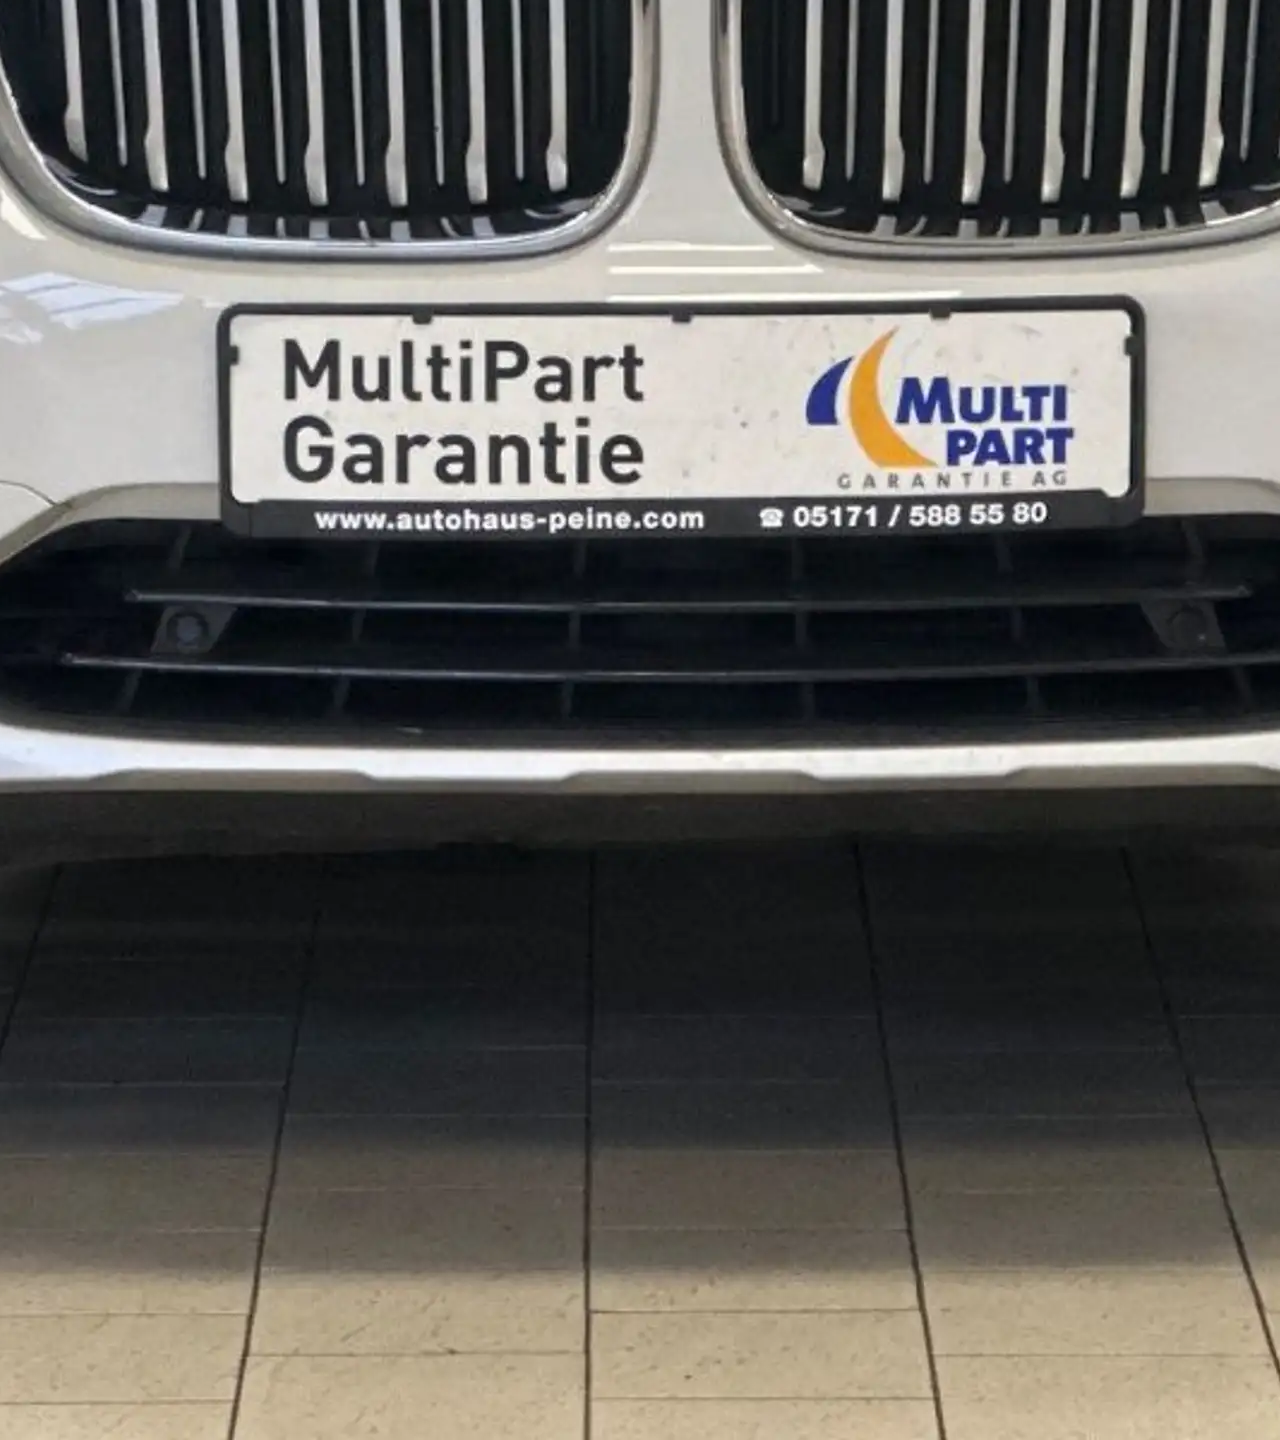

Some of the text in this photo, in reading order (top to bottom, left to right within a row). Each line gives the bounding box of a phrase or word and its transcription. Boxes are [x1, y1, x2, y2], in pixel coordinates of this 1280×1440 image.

[282, 338, 645, 403] MultiPart
[282, 414, 646, 485] Garantie
[946, 428, 1075, 467] PART
[837, 469, 1068, 491] GARANTIE AG
[314, 507, 706, 533] www.autohaus-peine.com
[792, 501, 1048, 528] 05171 / 588 55 80
